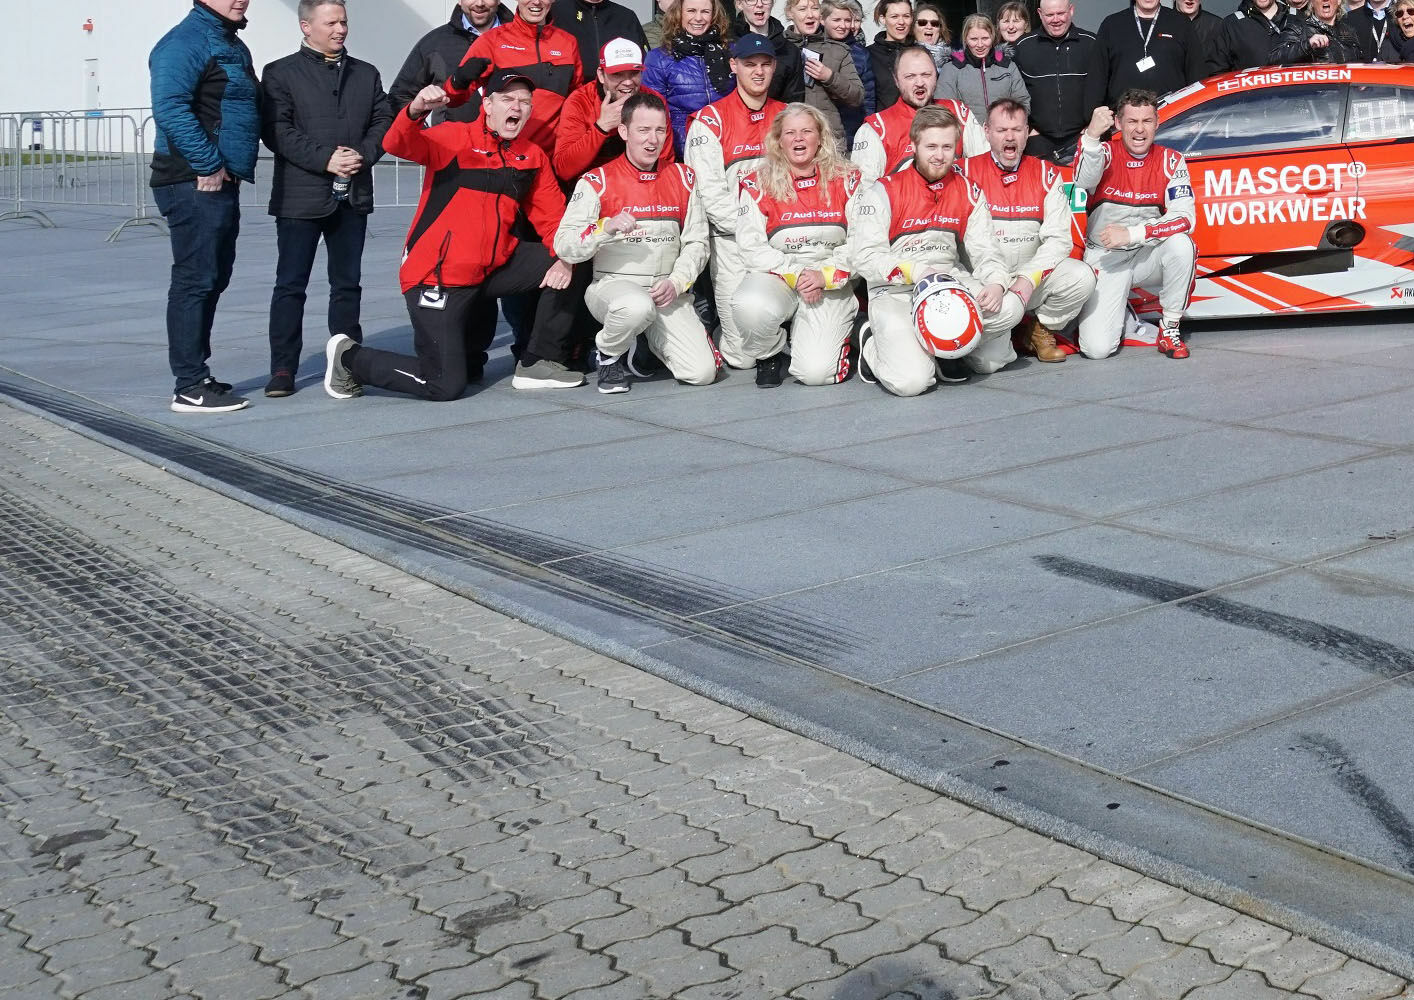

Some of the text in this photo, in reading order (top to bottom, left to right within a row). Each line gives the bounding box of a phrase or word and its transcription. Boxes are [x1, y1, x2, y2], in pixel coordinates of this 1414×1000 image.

[1241, 69, 1352, 87] KRISTENSEN
[1113, 190, 1158, 200] Audi Sport
[632, 205, 680, 213] Audi Sport
[992, 205, 1040, 213] Audi Sport
[1203, 196, 1368, 227] WORKWEAR
[792, 210, 841, 219] Audi Sport
[938, 215, 960, 225] Sport
[645, 235, 676, 243] Service
[784, 235, 808, 244] Audi
[1003, 236, 1035, 244] Service
[784, 243, 803, 251] Top
[920, 243, 951, 252] Service
